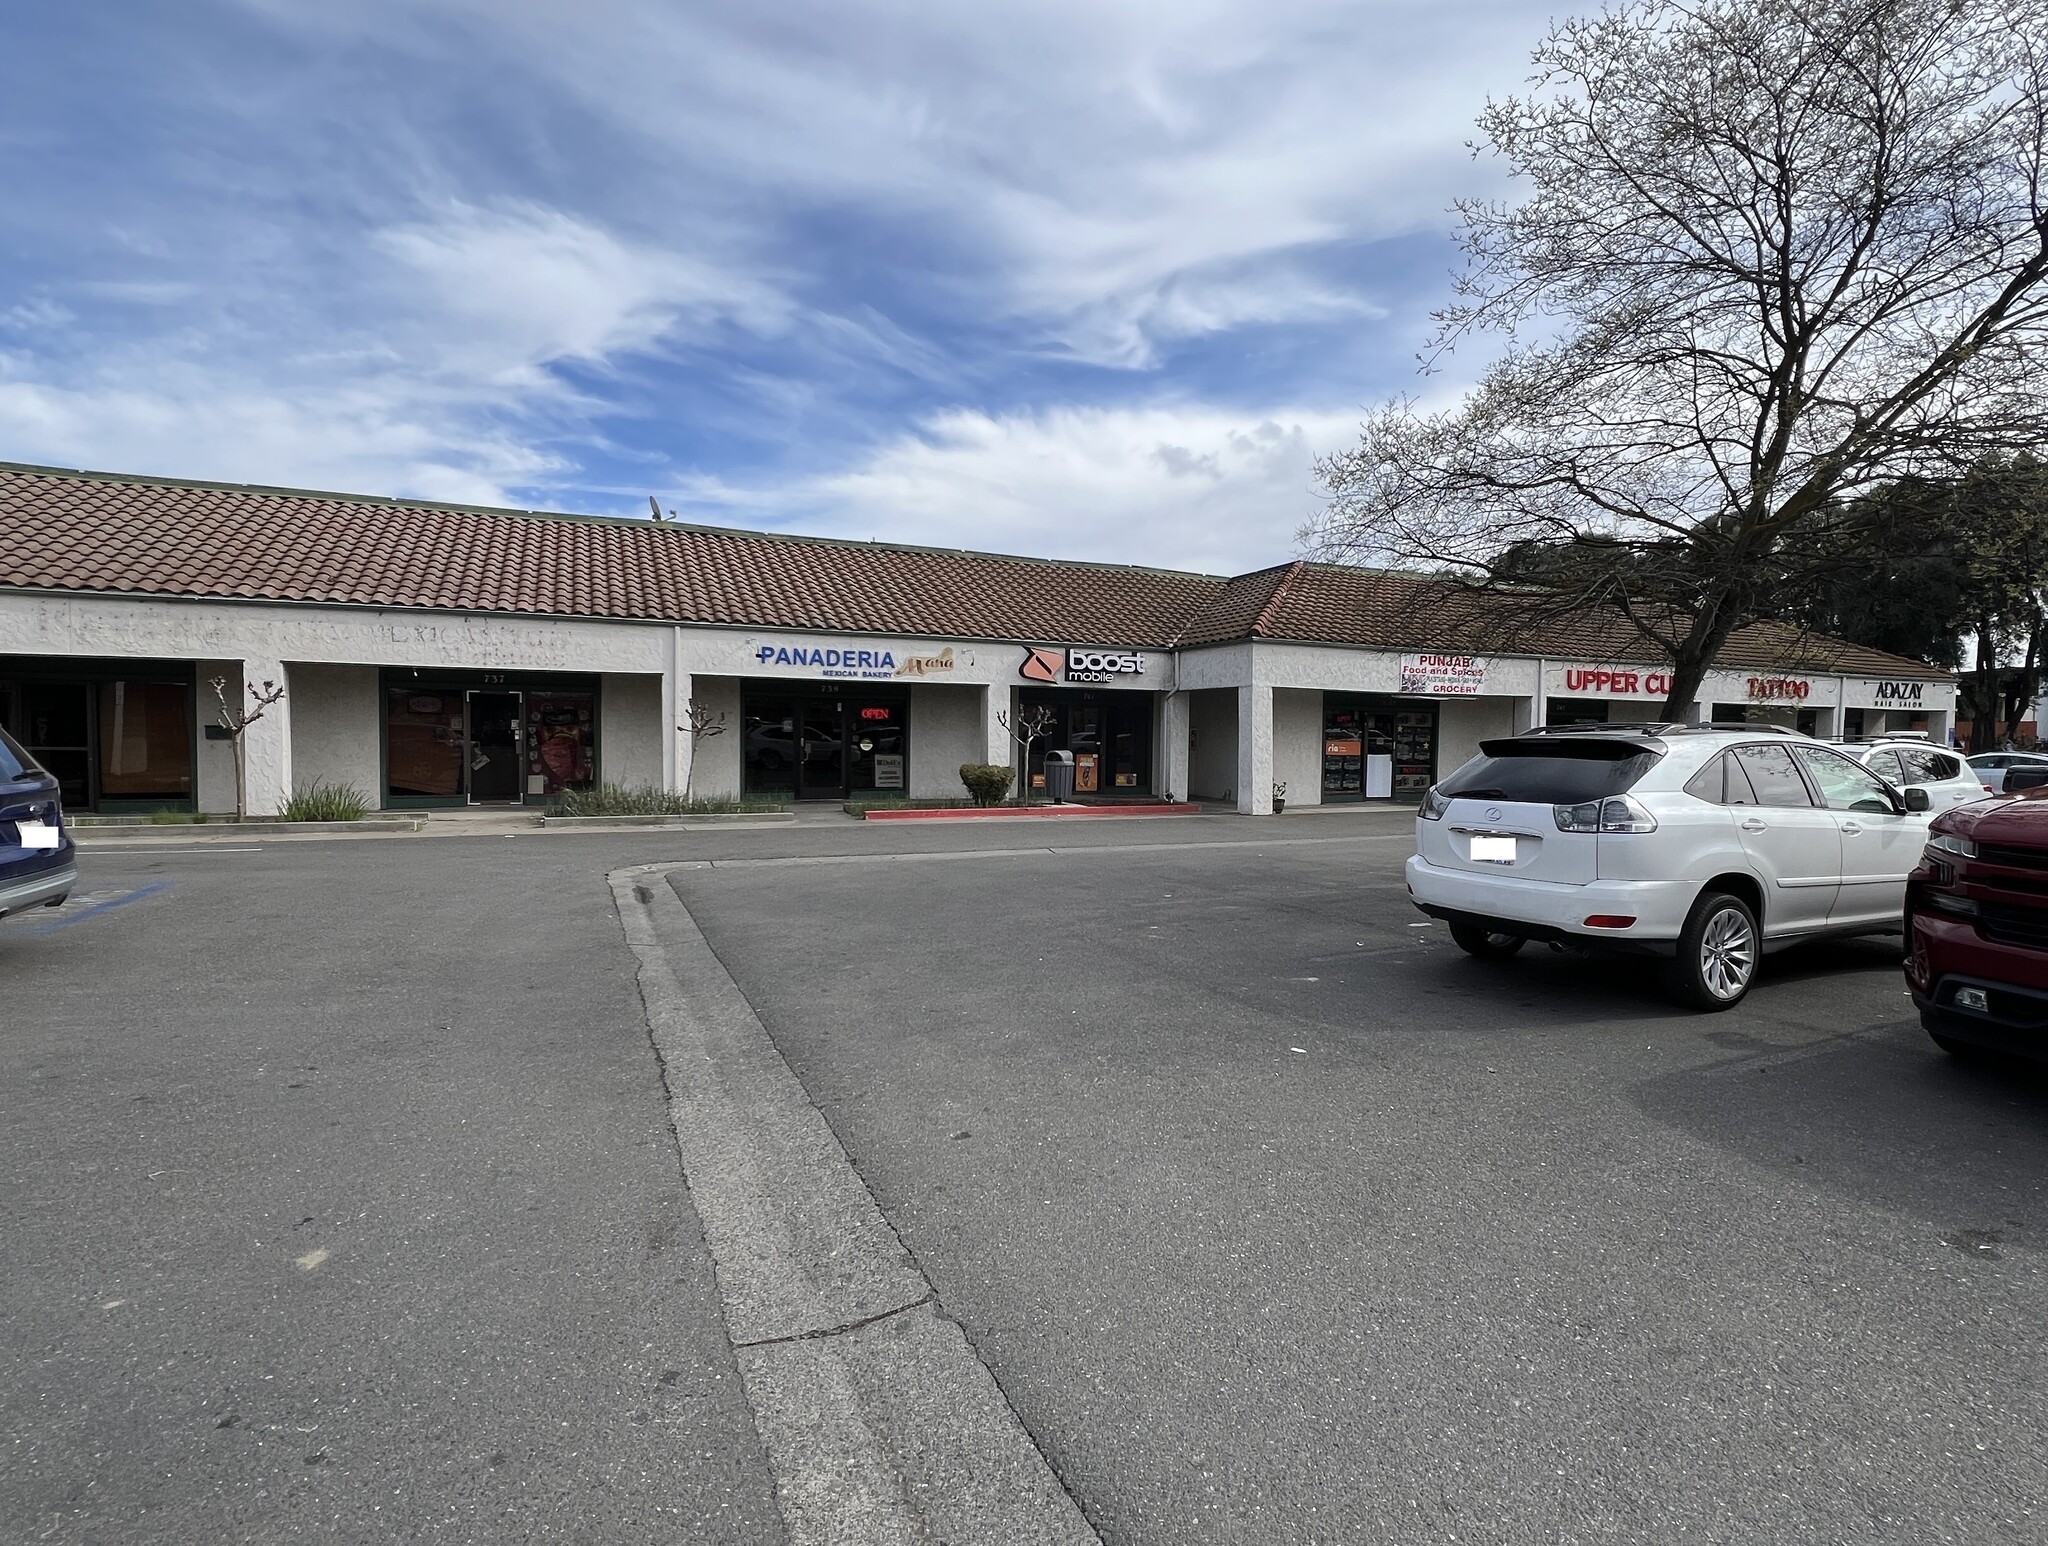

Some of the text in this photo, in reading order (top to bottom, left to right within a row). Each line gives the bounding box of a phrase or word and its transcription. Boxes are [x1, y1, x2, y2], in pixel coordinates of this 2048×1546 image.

[761, 646, 895, 668] PANADERIA
[1069, 648, 1146, 673] boost
[822, 670, 893, 679] MEXICAN BAKERY
[1069, 671, 1114, 682] mobile
[1403, 666, 1427, 674] Food
[1430, 667, 1448, 675] and
[484, 674, 505, 684] 737
[1567, 669, 1676, 695] UPPER CU
[1433, 685, 1477, 693] GROCERY
[1747, 678, 1810, 699] TATTOO
[1875, 681, 1924, 699] ADAZAY
[861, 708, 890, 720] OPEN
